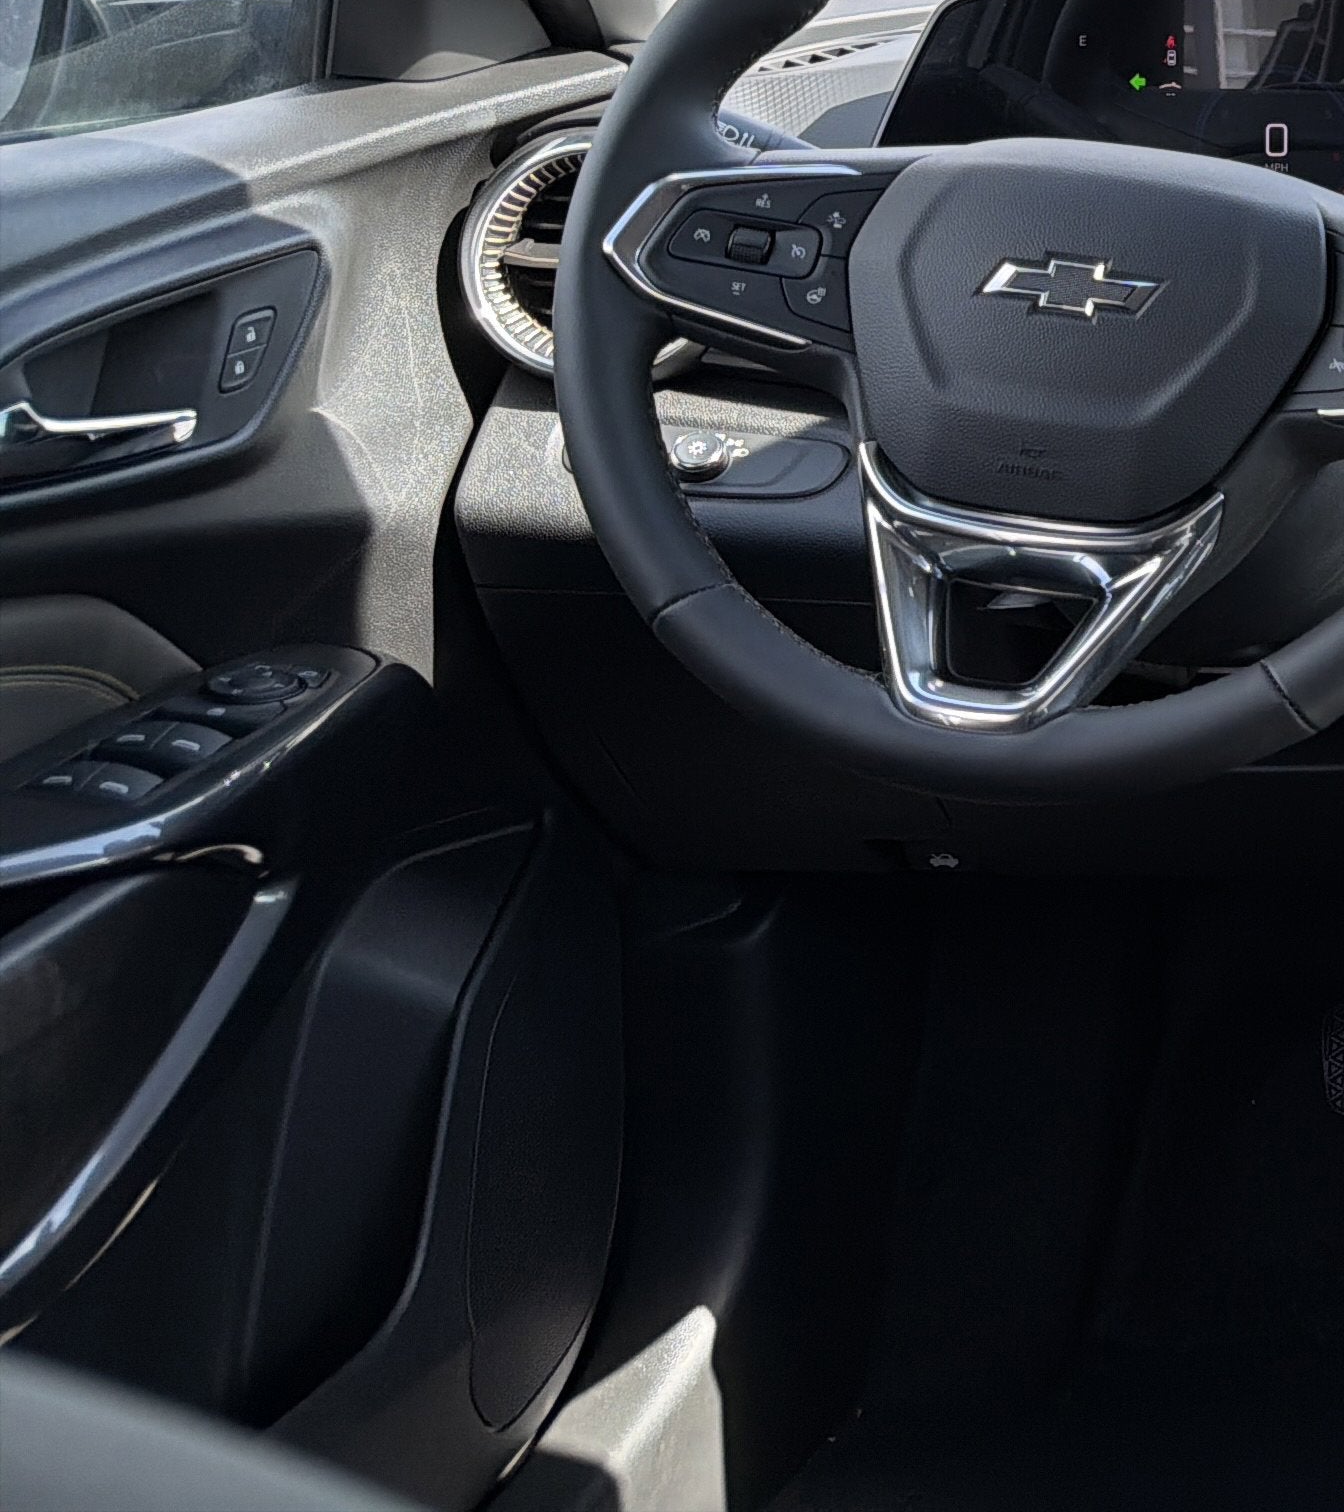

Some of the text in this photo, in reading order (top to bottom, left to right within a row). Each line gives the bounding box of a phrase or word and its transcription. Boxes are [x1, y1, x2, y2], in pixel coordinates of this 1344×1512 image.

[1079, 34, 1088, 47] E
[1265, 123, 1289, 158] 0
[731, 281, 747, 291] SET
